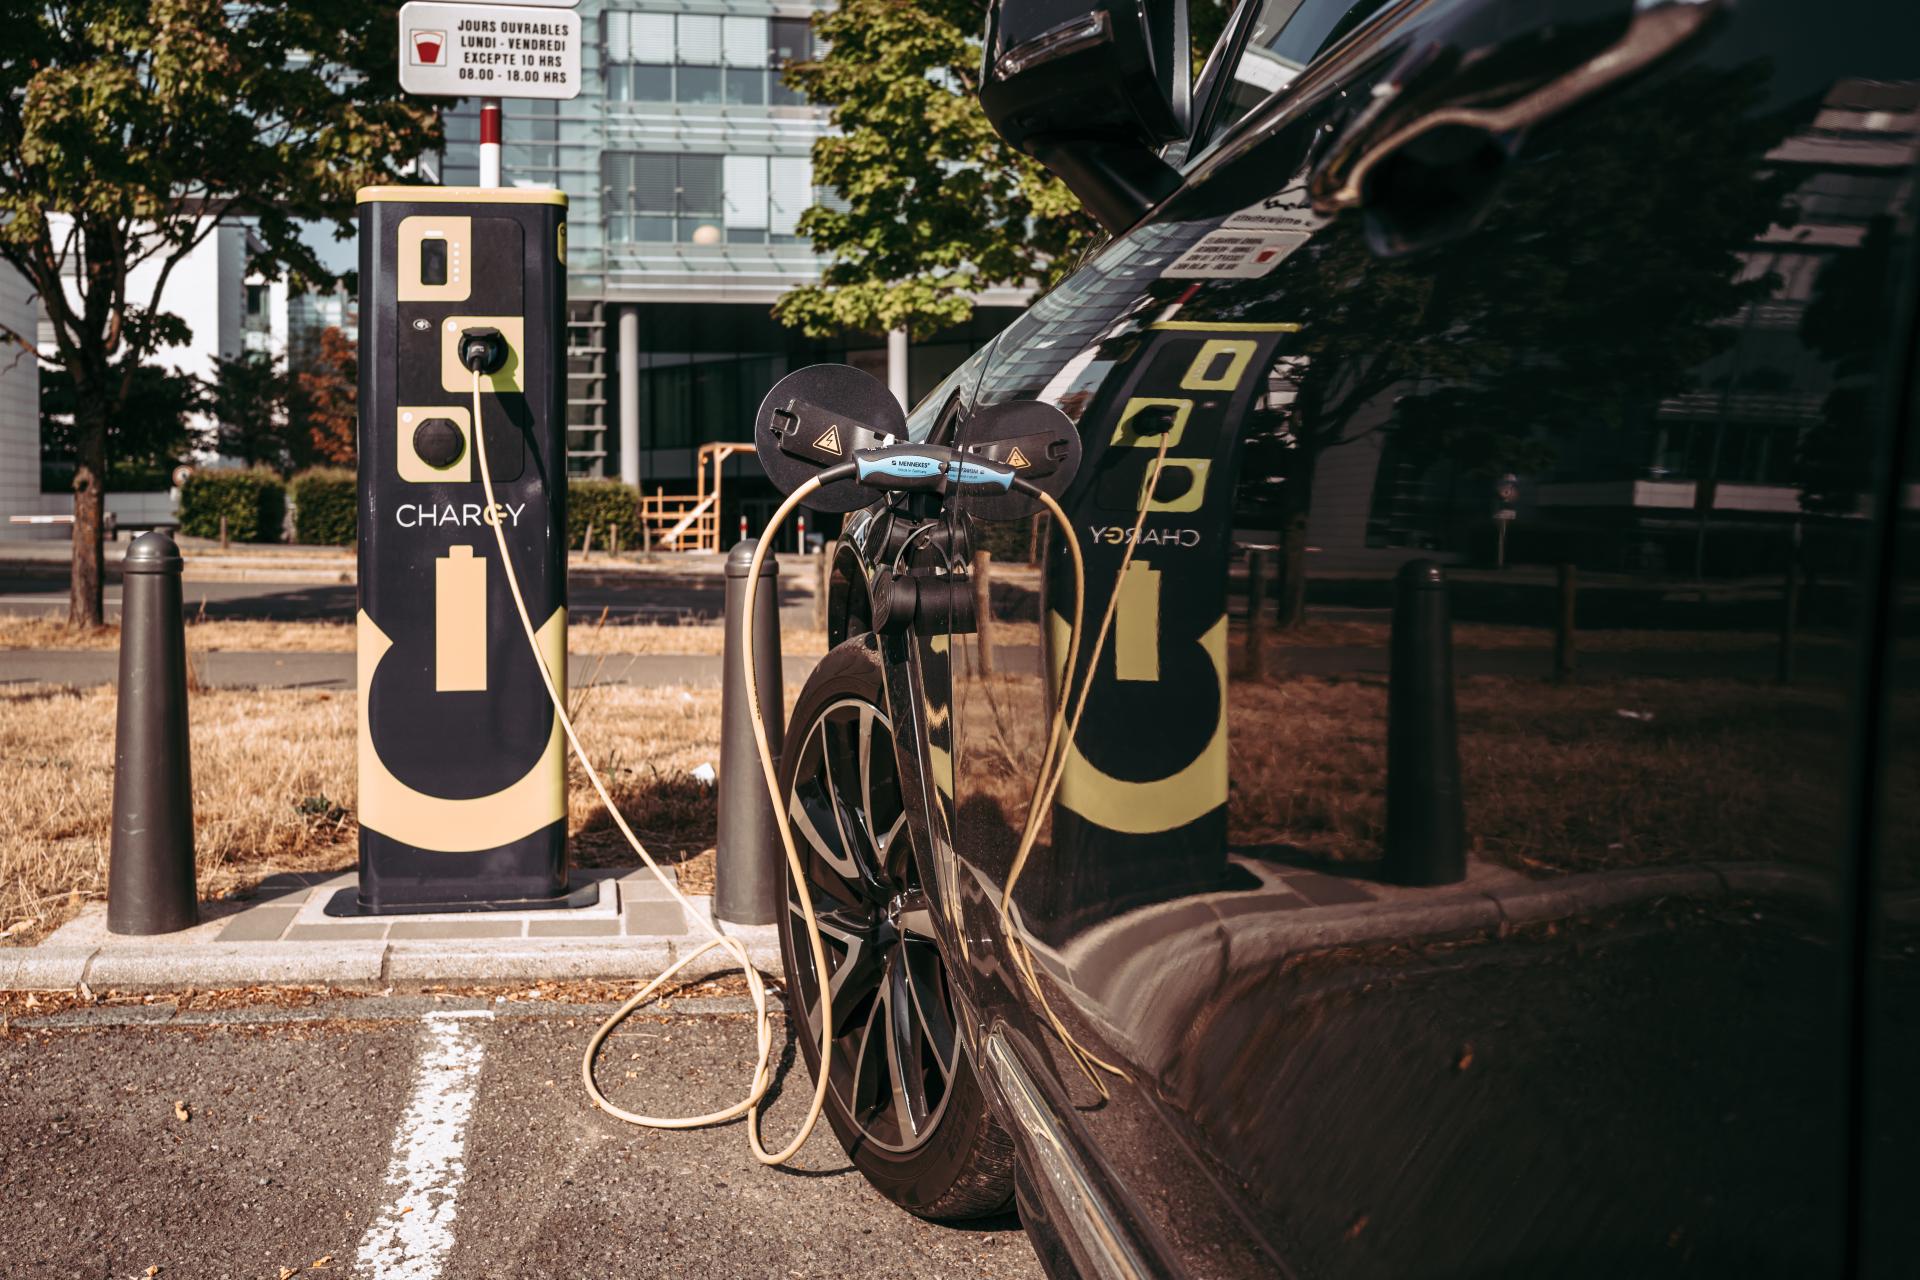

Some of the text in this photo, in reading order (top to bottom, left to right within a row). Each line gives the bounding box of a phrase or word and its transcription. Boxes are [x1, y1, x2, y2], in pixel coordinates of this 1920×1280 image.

[457, 20, 569, 36] JOURS OUVRABLES
[461, 36, 496, 48] LUNDI
[508, 38, 566, 51] VENDREDI
[464, 52, 562, 67] EXCEPTE 10 HRS
[459, 68, 494, 81] 08.00
[507, 70, 539, 82] 18.00
[543, 71, 567, 83] HRS
[396, 503, 526, 527] CHARGY
